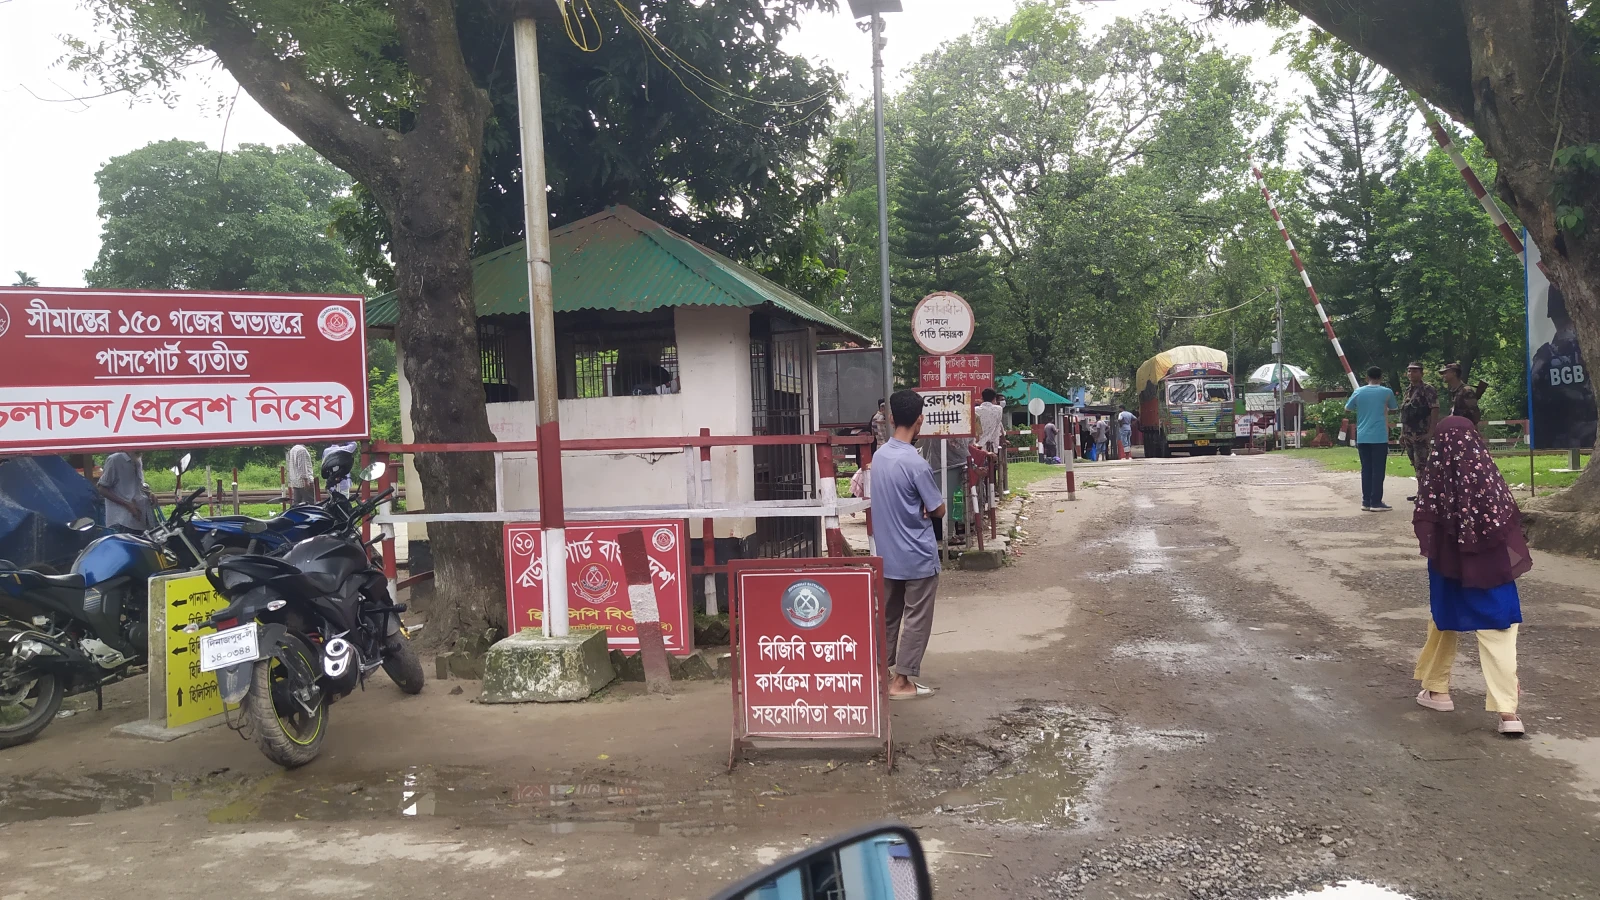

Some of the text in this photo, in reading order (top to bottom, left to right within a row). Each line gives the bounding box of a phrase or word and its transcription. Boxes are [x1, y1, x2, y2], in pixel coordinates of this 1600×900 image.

[25, 298, 112, 334] সীমান্তের
[118, 309, 161, 334] ১৫০
[169, 308, 224, 334] গজের
[228, 311, 304, 336] অভ্যন্তরে
[926, 318, 948, 326] সামনে
[920, 327, 936, 339] গতি
[95, 341, 249, 374] পাসপোর্ট ব্যতীত
[1550, 365, 1584, 386] BGB
[247, 387, 347, 423] নিষেধ
[516, 537, 532, 552] ২০
[189, 591, 211, 607] পানামা
[758, 635, 858, 663] বিজিবি তল্লাশি
[754, 666, 863, 693] কার্যক্রম চলমান
[751, 699, 868, 726] সহযোগিতা কাম্য
